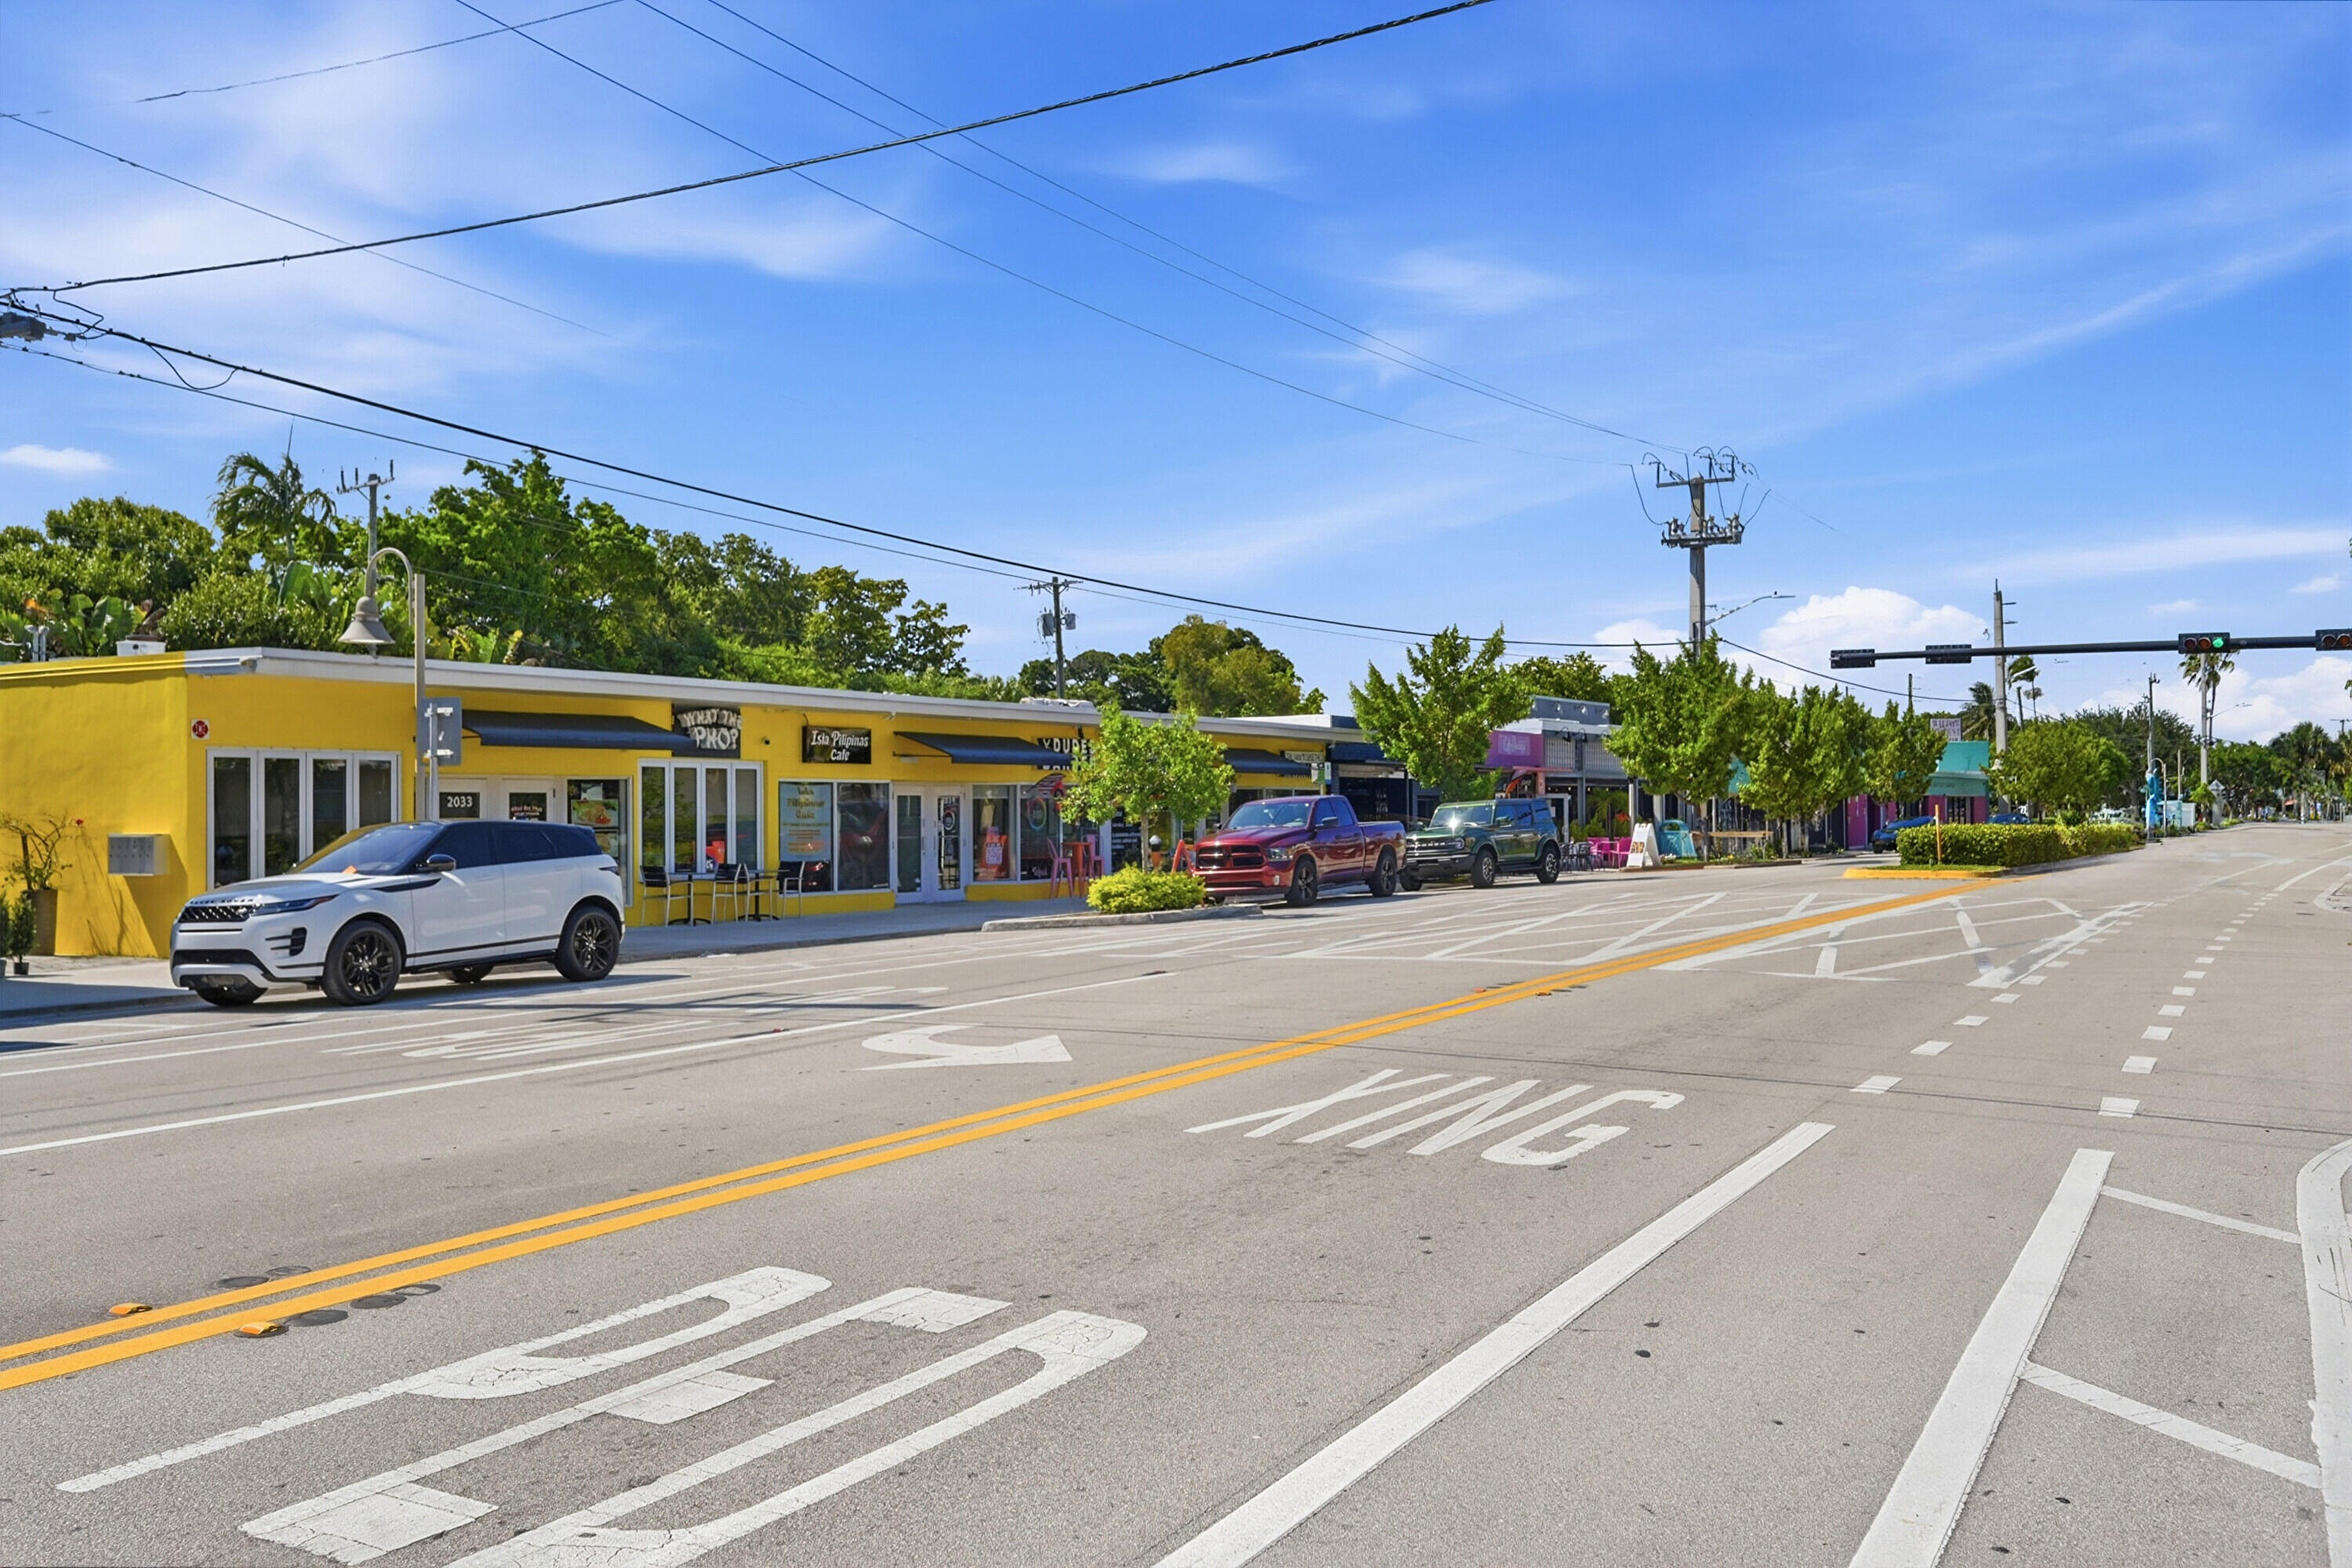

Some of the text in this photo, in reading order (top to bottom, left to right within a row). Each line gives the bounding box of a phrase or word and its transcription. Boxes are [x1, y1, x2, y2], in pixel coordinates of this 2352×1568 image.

[681, 709, 720, 728] WHAT
[811, 730, 869, 749] Isla Pilipinas
[830, 749, 851, 761] Cafe
[447, 796, 473, 808] 2033
[1183, 1069, 1685, 1166] XING
[56, 1265, 1149, 1568] PED
